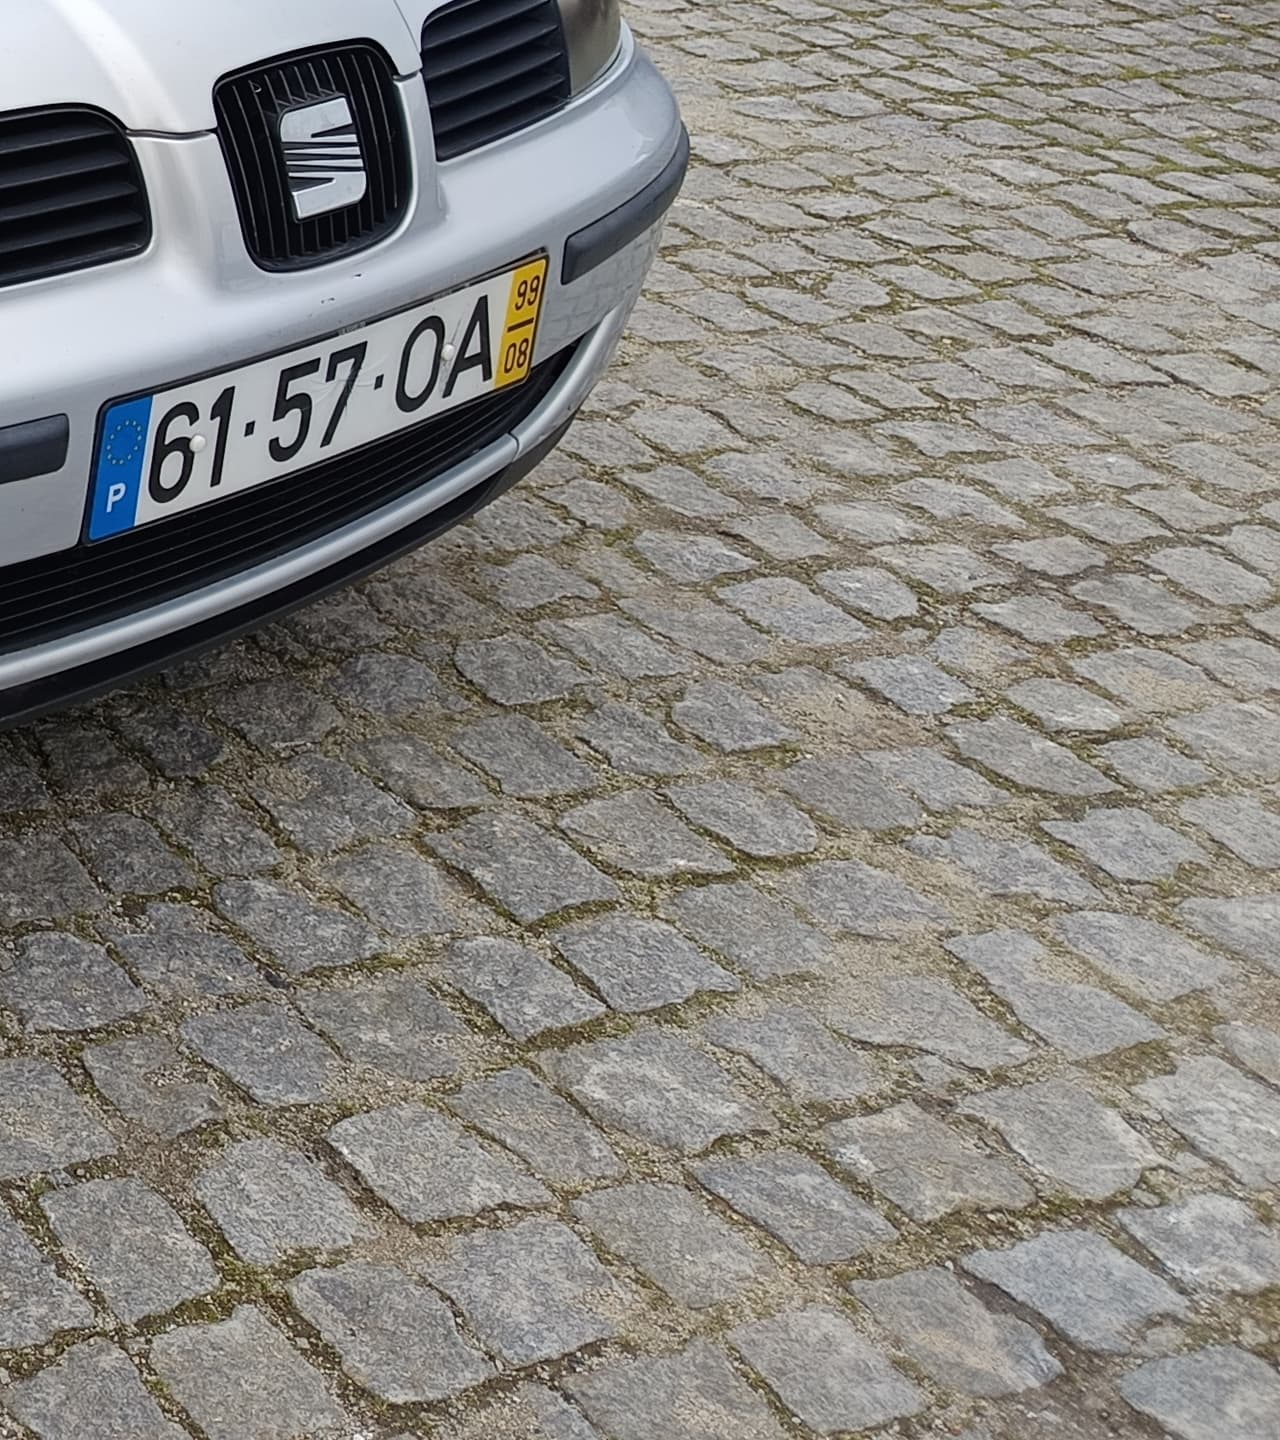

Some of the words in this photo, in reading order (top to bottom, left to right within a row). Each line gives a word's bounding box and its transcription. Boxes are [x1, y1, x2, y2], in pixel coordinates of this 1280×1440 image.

[513, 274, 541, 312] 99
[503, 337, 530, 375] 08
[105, 482, 127, 513] P
